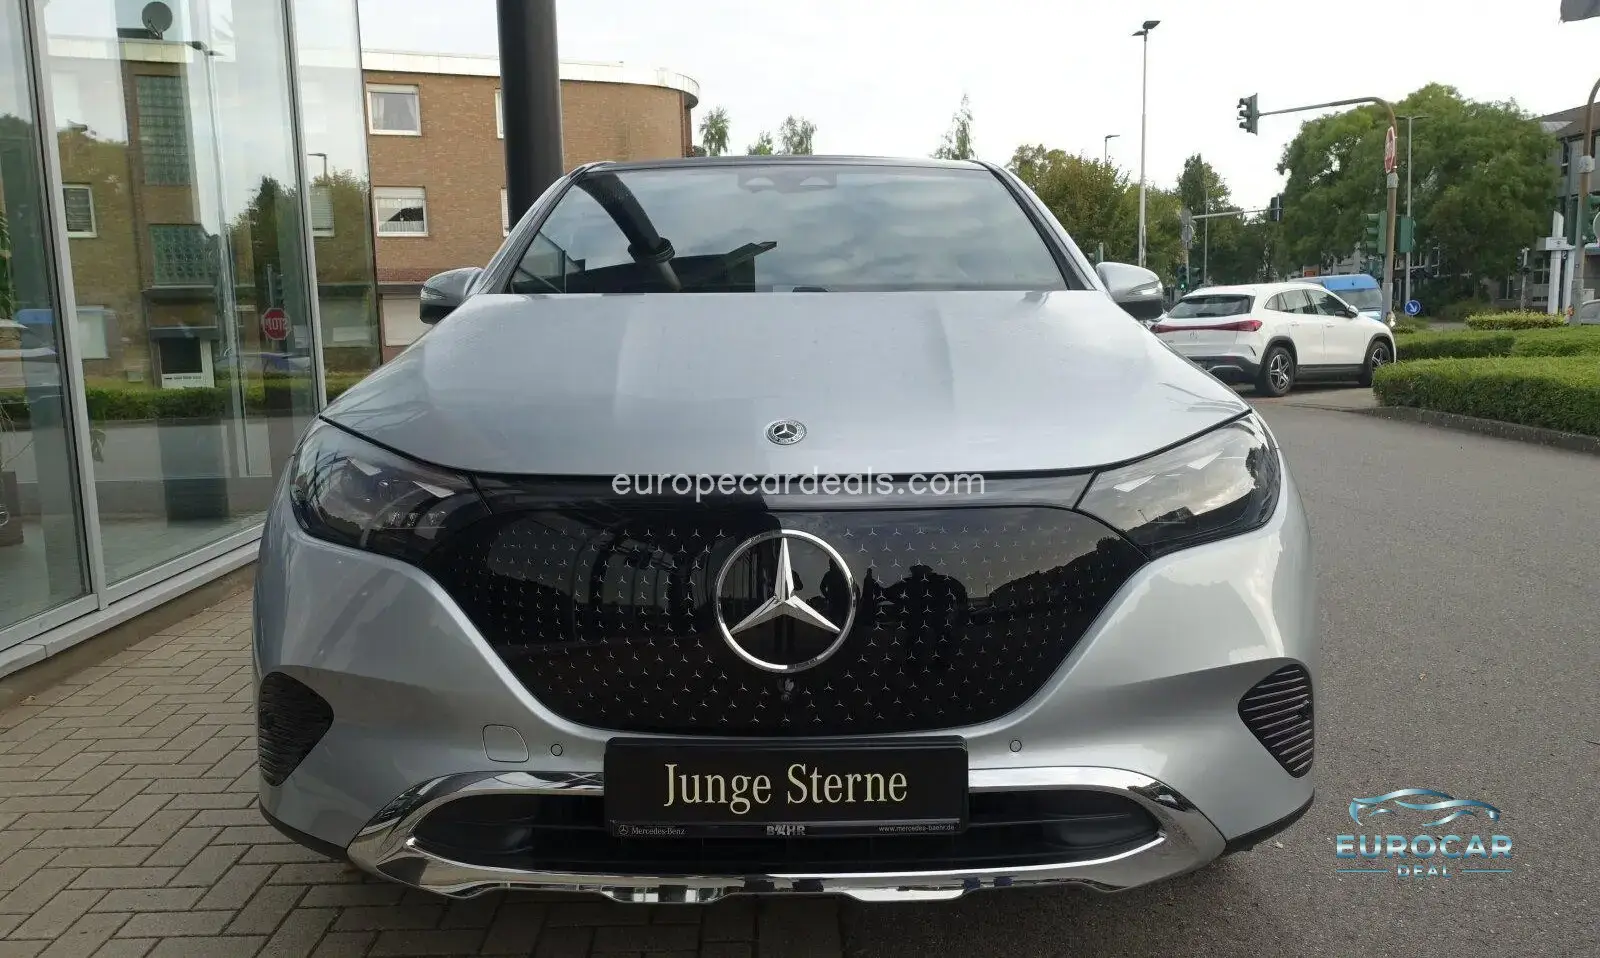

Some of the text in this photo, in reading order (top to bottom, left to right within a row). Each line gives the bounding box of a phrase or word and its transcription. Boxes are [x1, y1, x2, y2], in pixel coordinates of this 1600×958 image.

[664, 763, 907, 815] Junge Sterne
[631, 827, 685, 835] Mercedes-Benz
